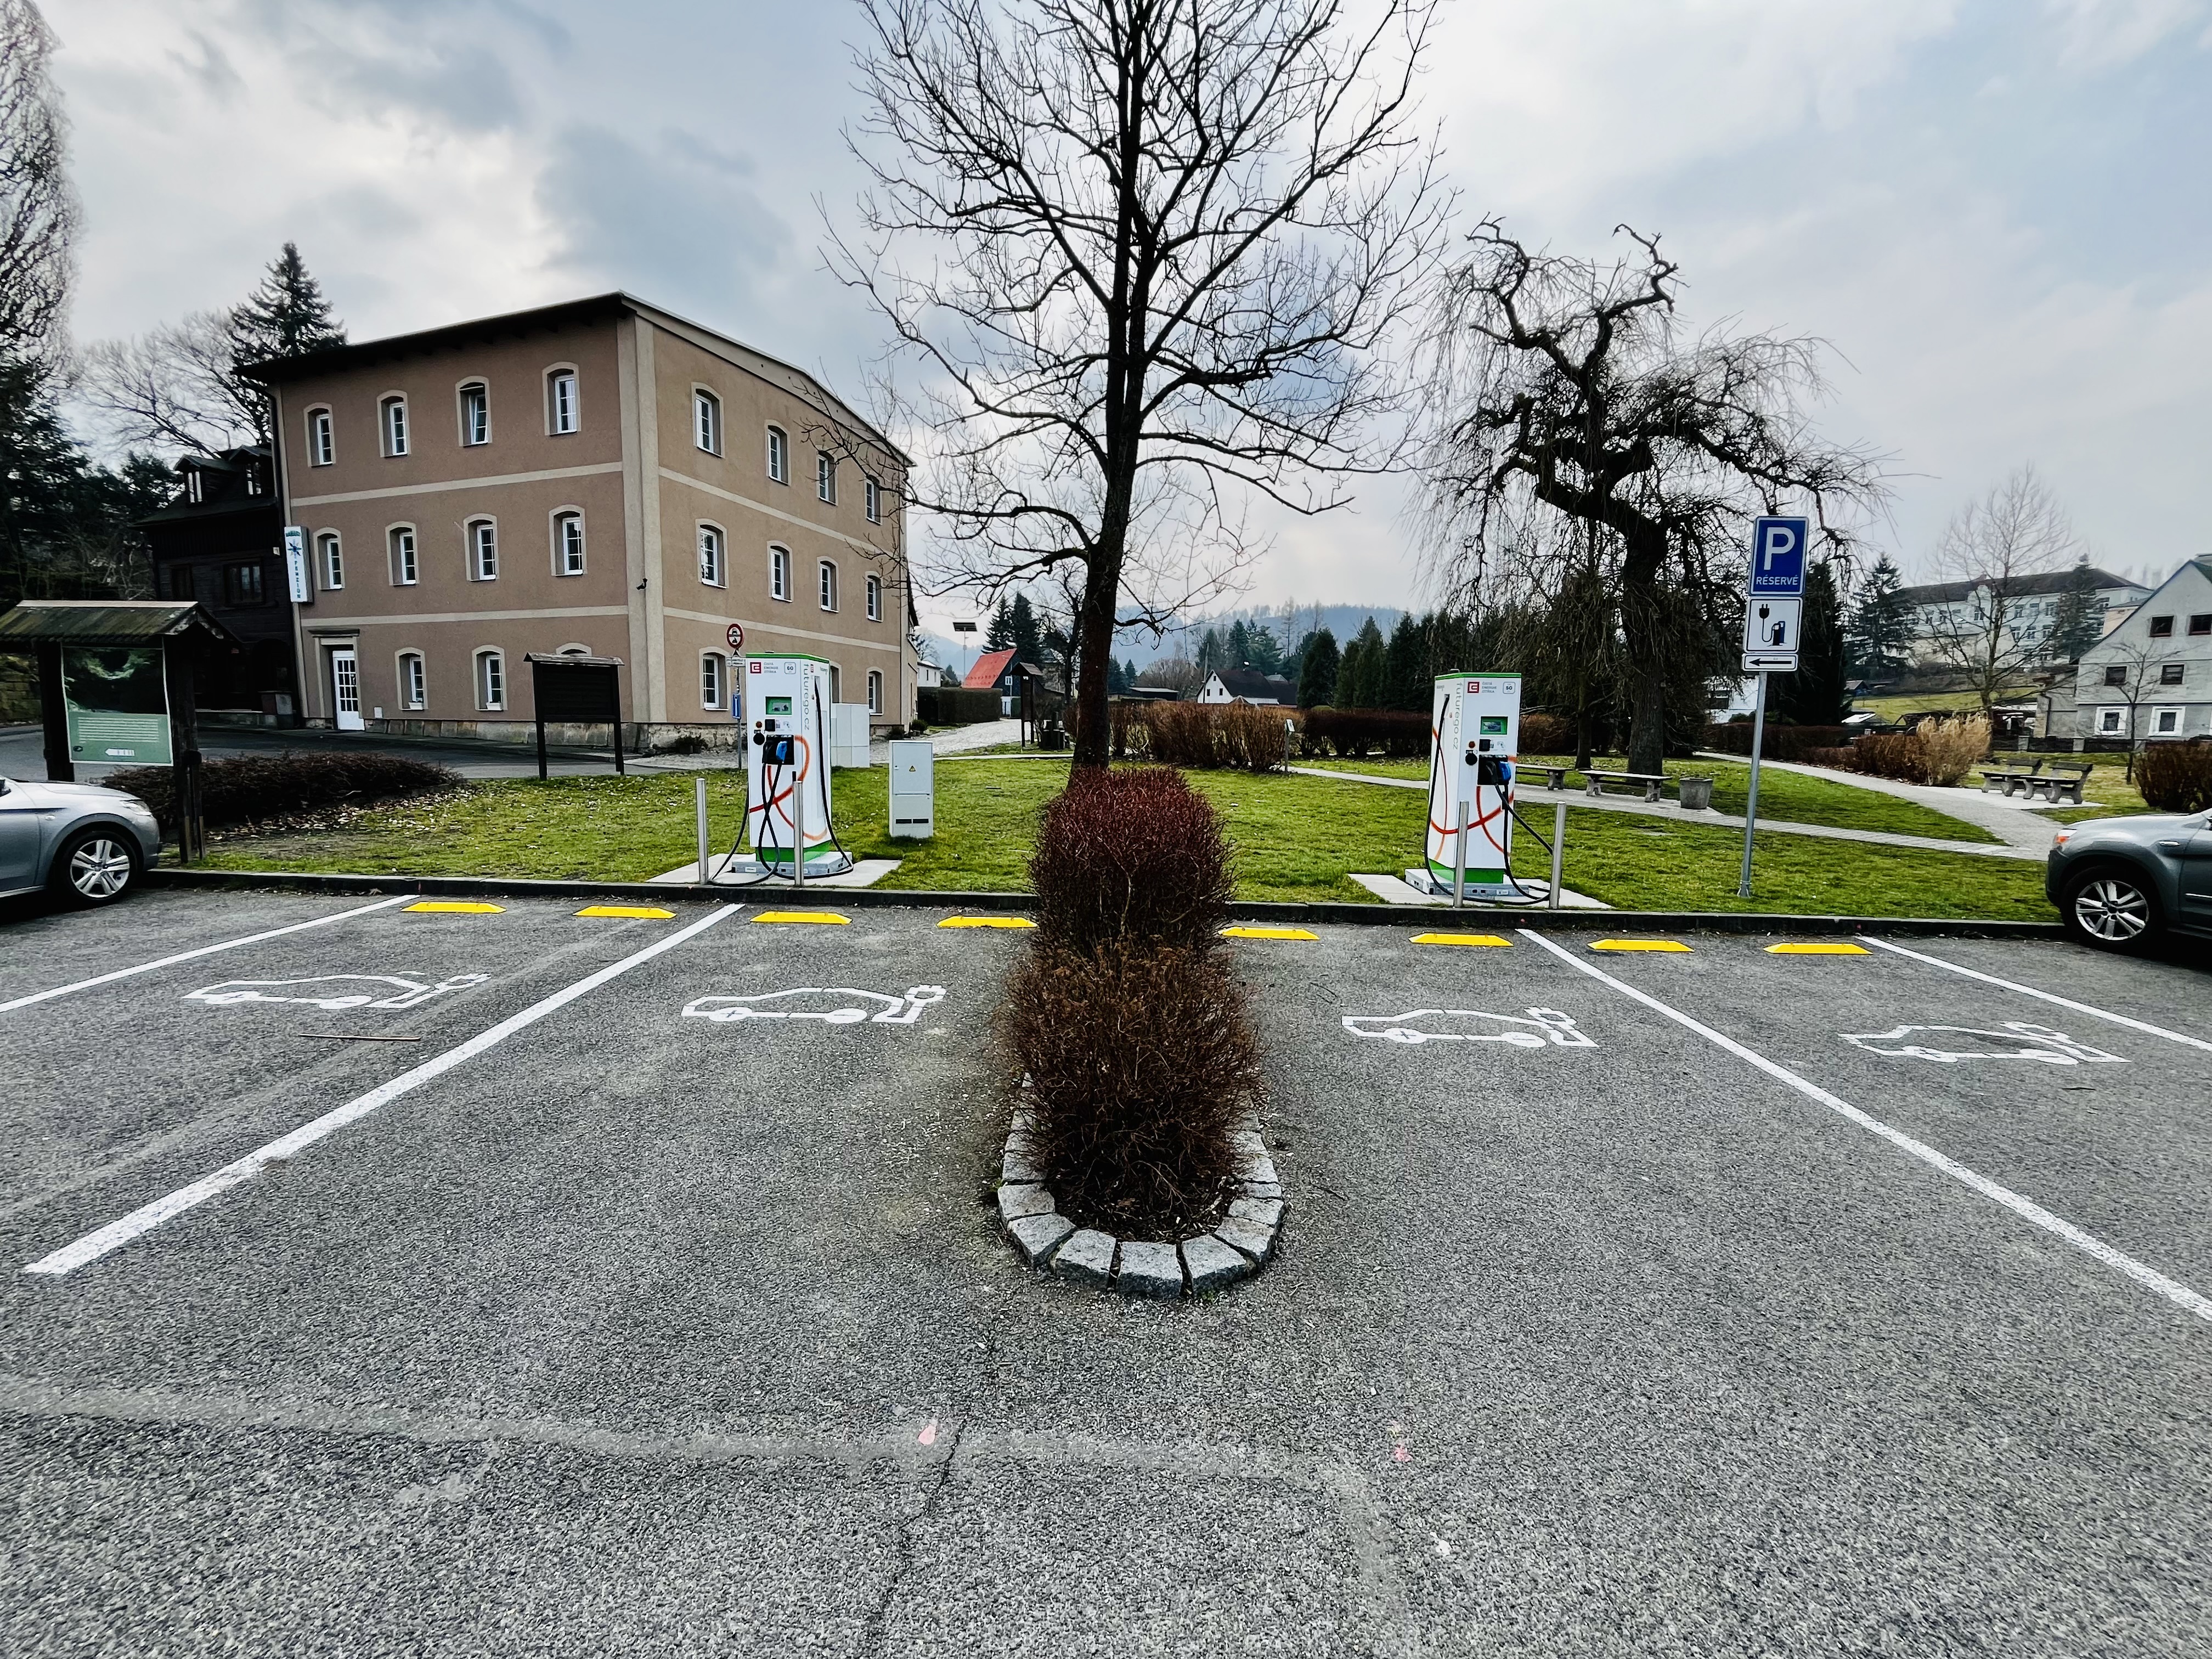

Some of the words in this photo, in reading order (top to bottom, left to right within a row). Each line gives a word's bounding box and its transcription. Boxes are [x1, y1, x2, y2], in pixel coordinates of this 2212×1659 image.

[1764, 527, 1795, 570] P
[1756, 574, 1799, 585] RÉSERVÉ
[1453, 682, 1463, 750] futurego.cz
